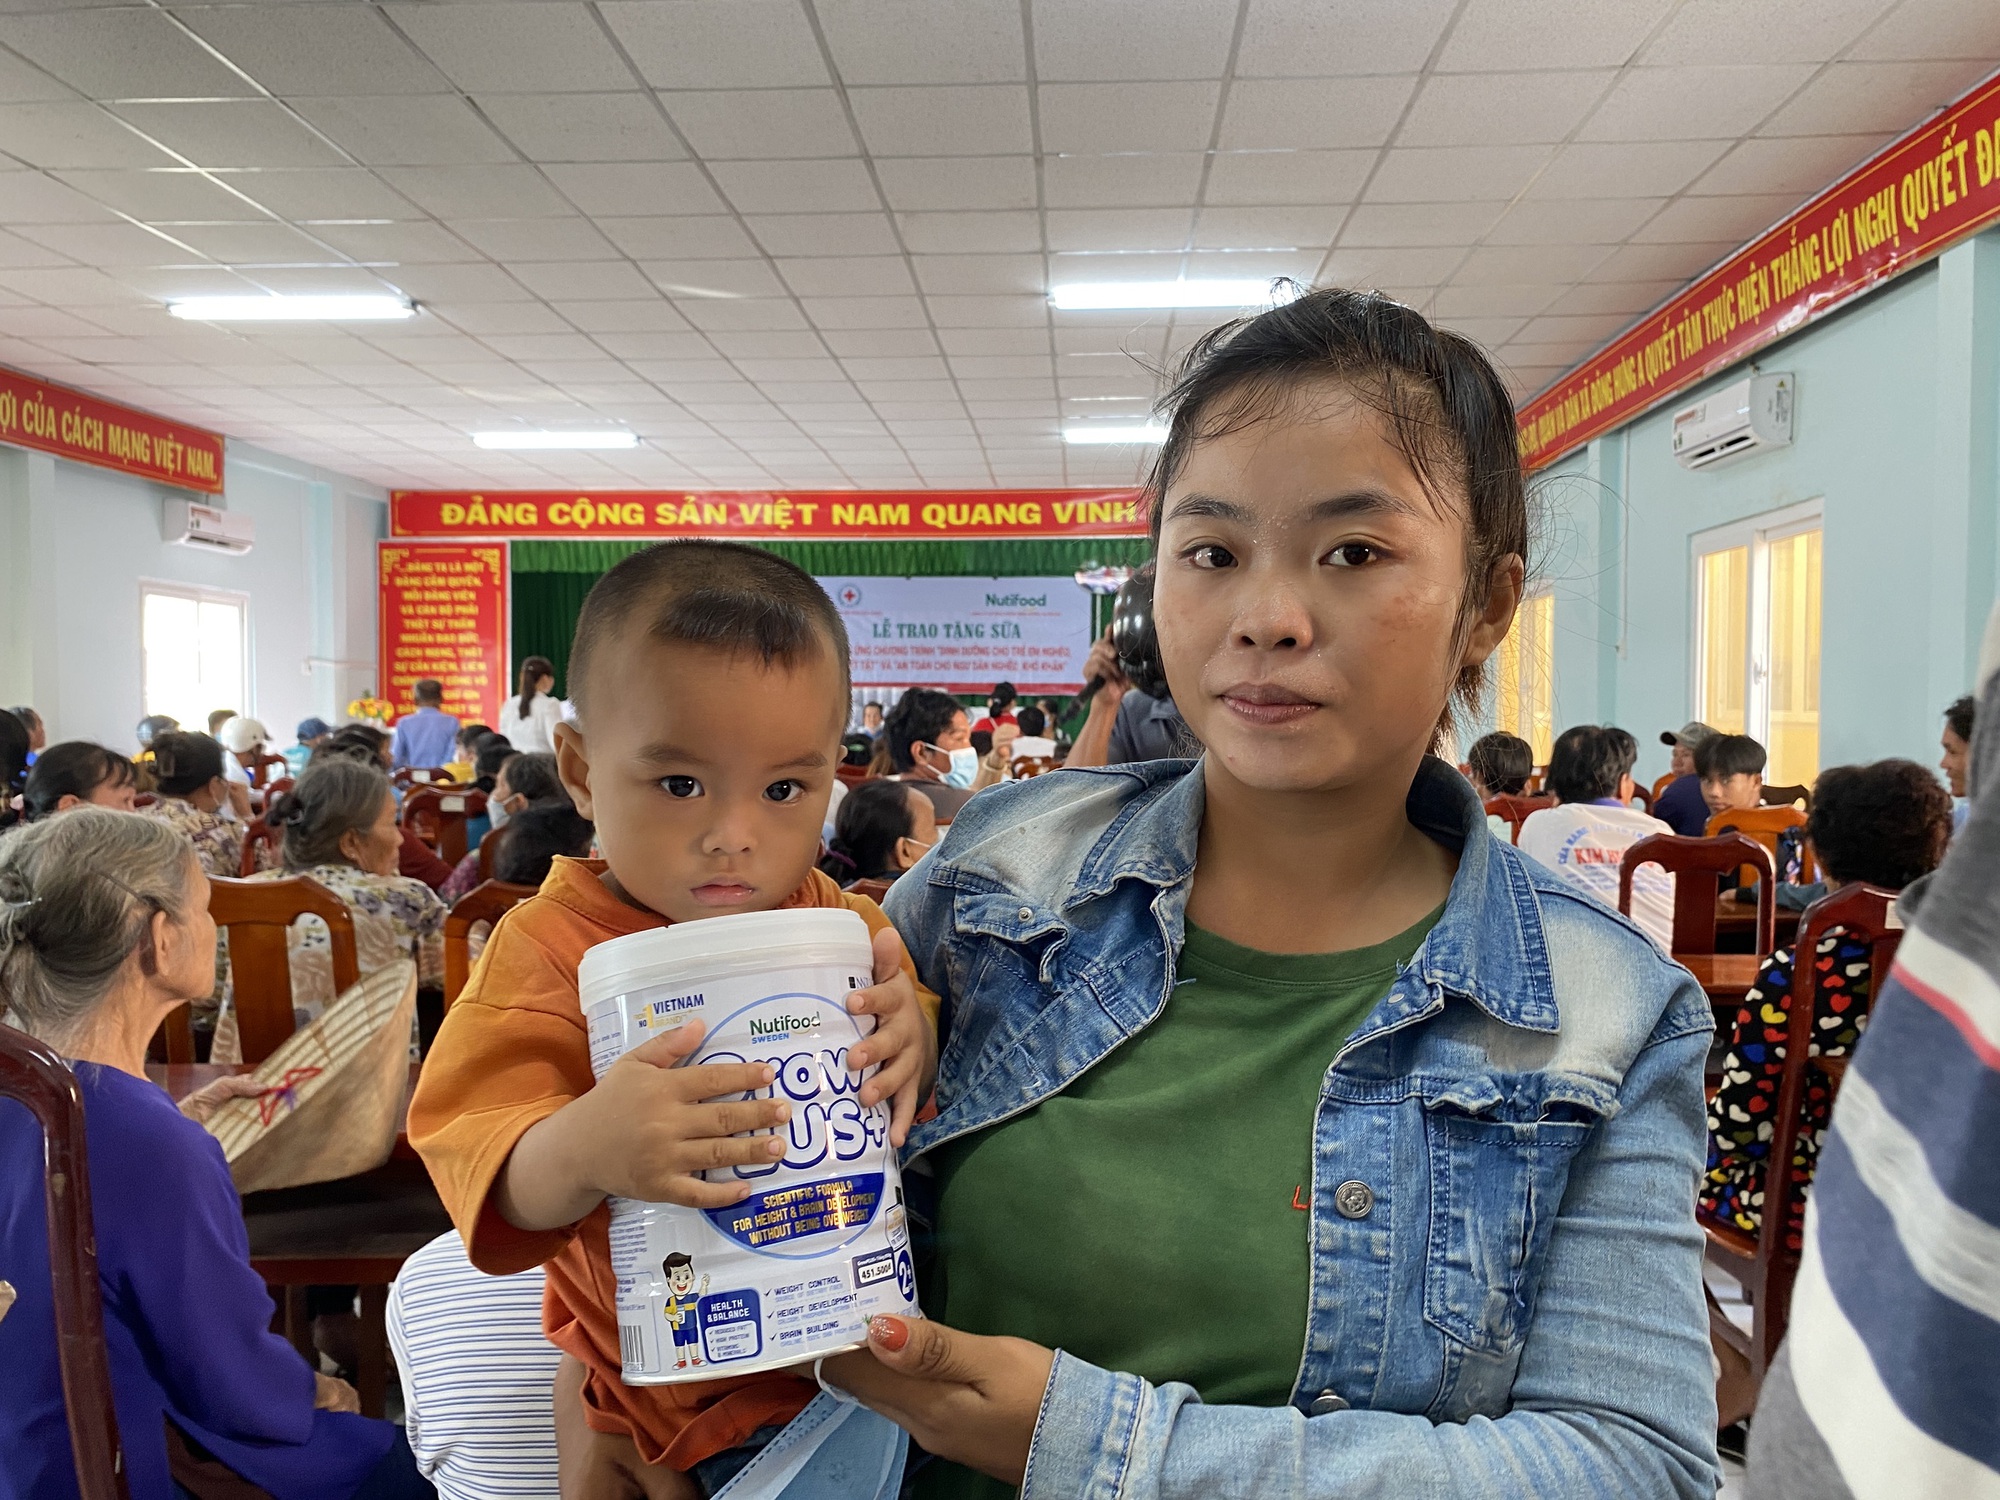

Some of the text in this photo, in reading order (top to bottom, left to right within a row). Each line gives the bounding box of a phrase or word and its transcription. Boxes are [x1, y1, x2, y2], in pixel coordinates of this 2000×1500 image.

[1636, 351, 1645, 388] A
[1645, 316, 1676, 388] QUYẾT
[1677, 308, 1703, 361] TÂM
[1702, 285, 1737, 345] THỰC
[1737, 261, 1771, 325] HIỆN
[1770, 225, 1822, 303] THẮNG
[1823, 208, 1853, 278] LỢI
[1853, 184, 1900, 248] NGHỊ
[1901, 123, 1968, 234] QUYẾT
[22, 390, 57, 441] CỦA
[61, 405, 103, 453] CÁCH
[108, 423, 150, 465] MẠNG
[153, 432, 183, 476] VIỆT
[440, 495, 1137, 529] ĐẢNG CỘNG SẢN VIỆT NAM QUANG VINH
[985, 593, 1047, 607] Nutifood
[872, 617, 1022, 641] LỄ TRAO TẶNG SỮA
[1574, 847, 1604, 865] KIM
[653, 993, 705, 1015] VIETNAM
[749, 1011, 821, 1035] Nutifood
[751, 1033, 789, 1045] SWEDEN
[763, 1180, 853, 1210] SCIENTIFIC FORMULA
[733, 1217, 752, 1233] FOR
[755, 1207, 789, 1227] HEIGHT
[790, 1206, 798, 1219] &
[799, 1200, 825, 1216] BRAIN
[749, 1223, 791, 1245] WITHOUT
[795, 1217, 820, 1233] BEING
[823, 1208, 869, 1227] OVEWEIGHT
[774, 1276, 841, 1296] WEIGHT CONTROL
[711, 1298, 743, 1312] HEALTH
[777, 1306, 804, 1318] HEIGHT
[808, 1293, 858, 1312] DEVELOPMENT
[780, 1321, 839, 1341] BRAIN BUILDING
